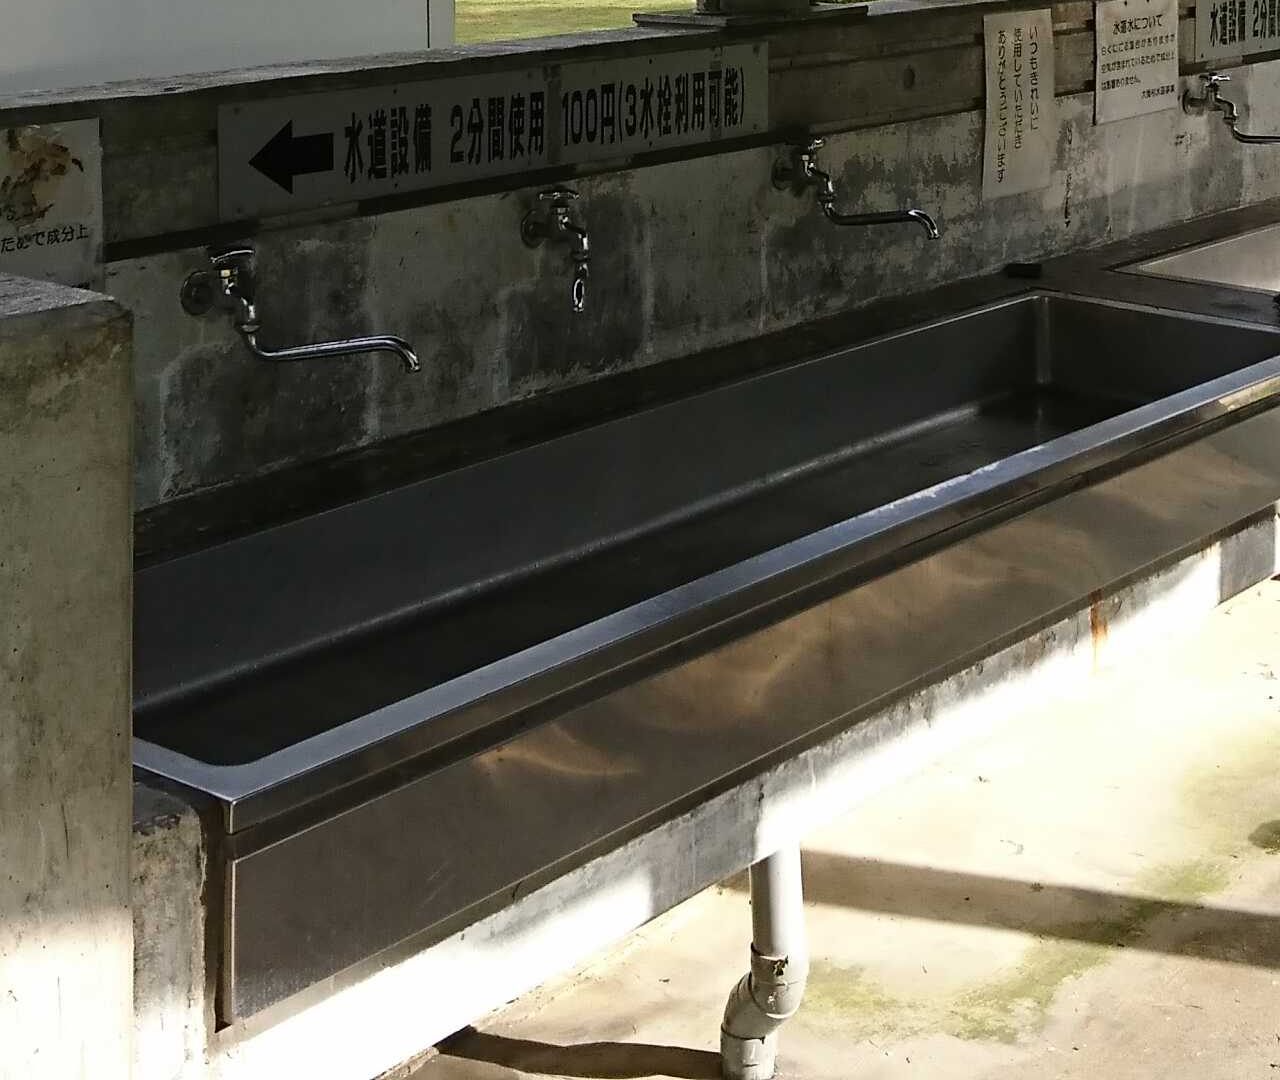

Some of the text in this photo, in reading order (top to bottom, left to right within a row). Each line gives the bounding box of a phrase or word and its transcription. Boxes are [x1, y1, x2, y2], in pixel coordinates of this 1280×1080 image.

[342, 63, 746, 184] 水道設備 2分間使用 100円(3水栓利用可能)
